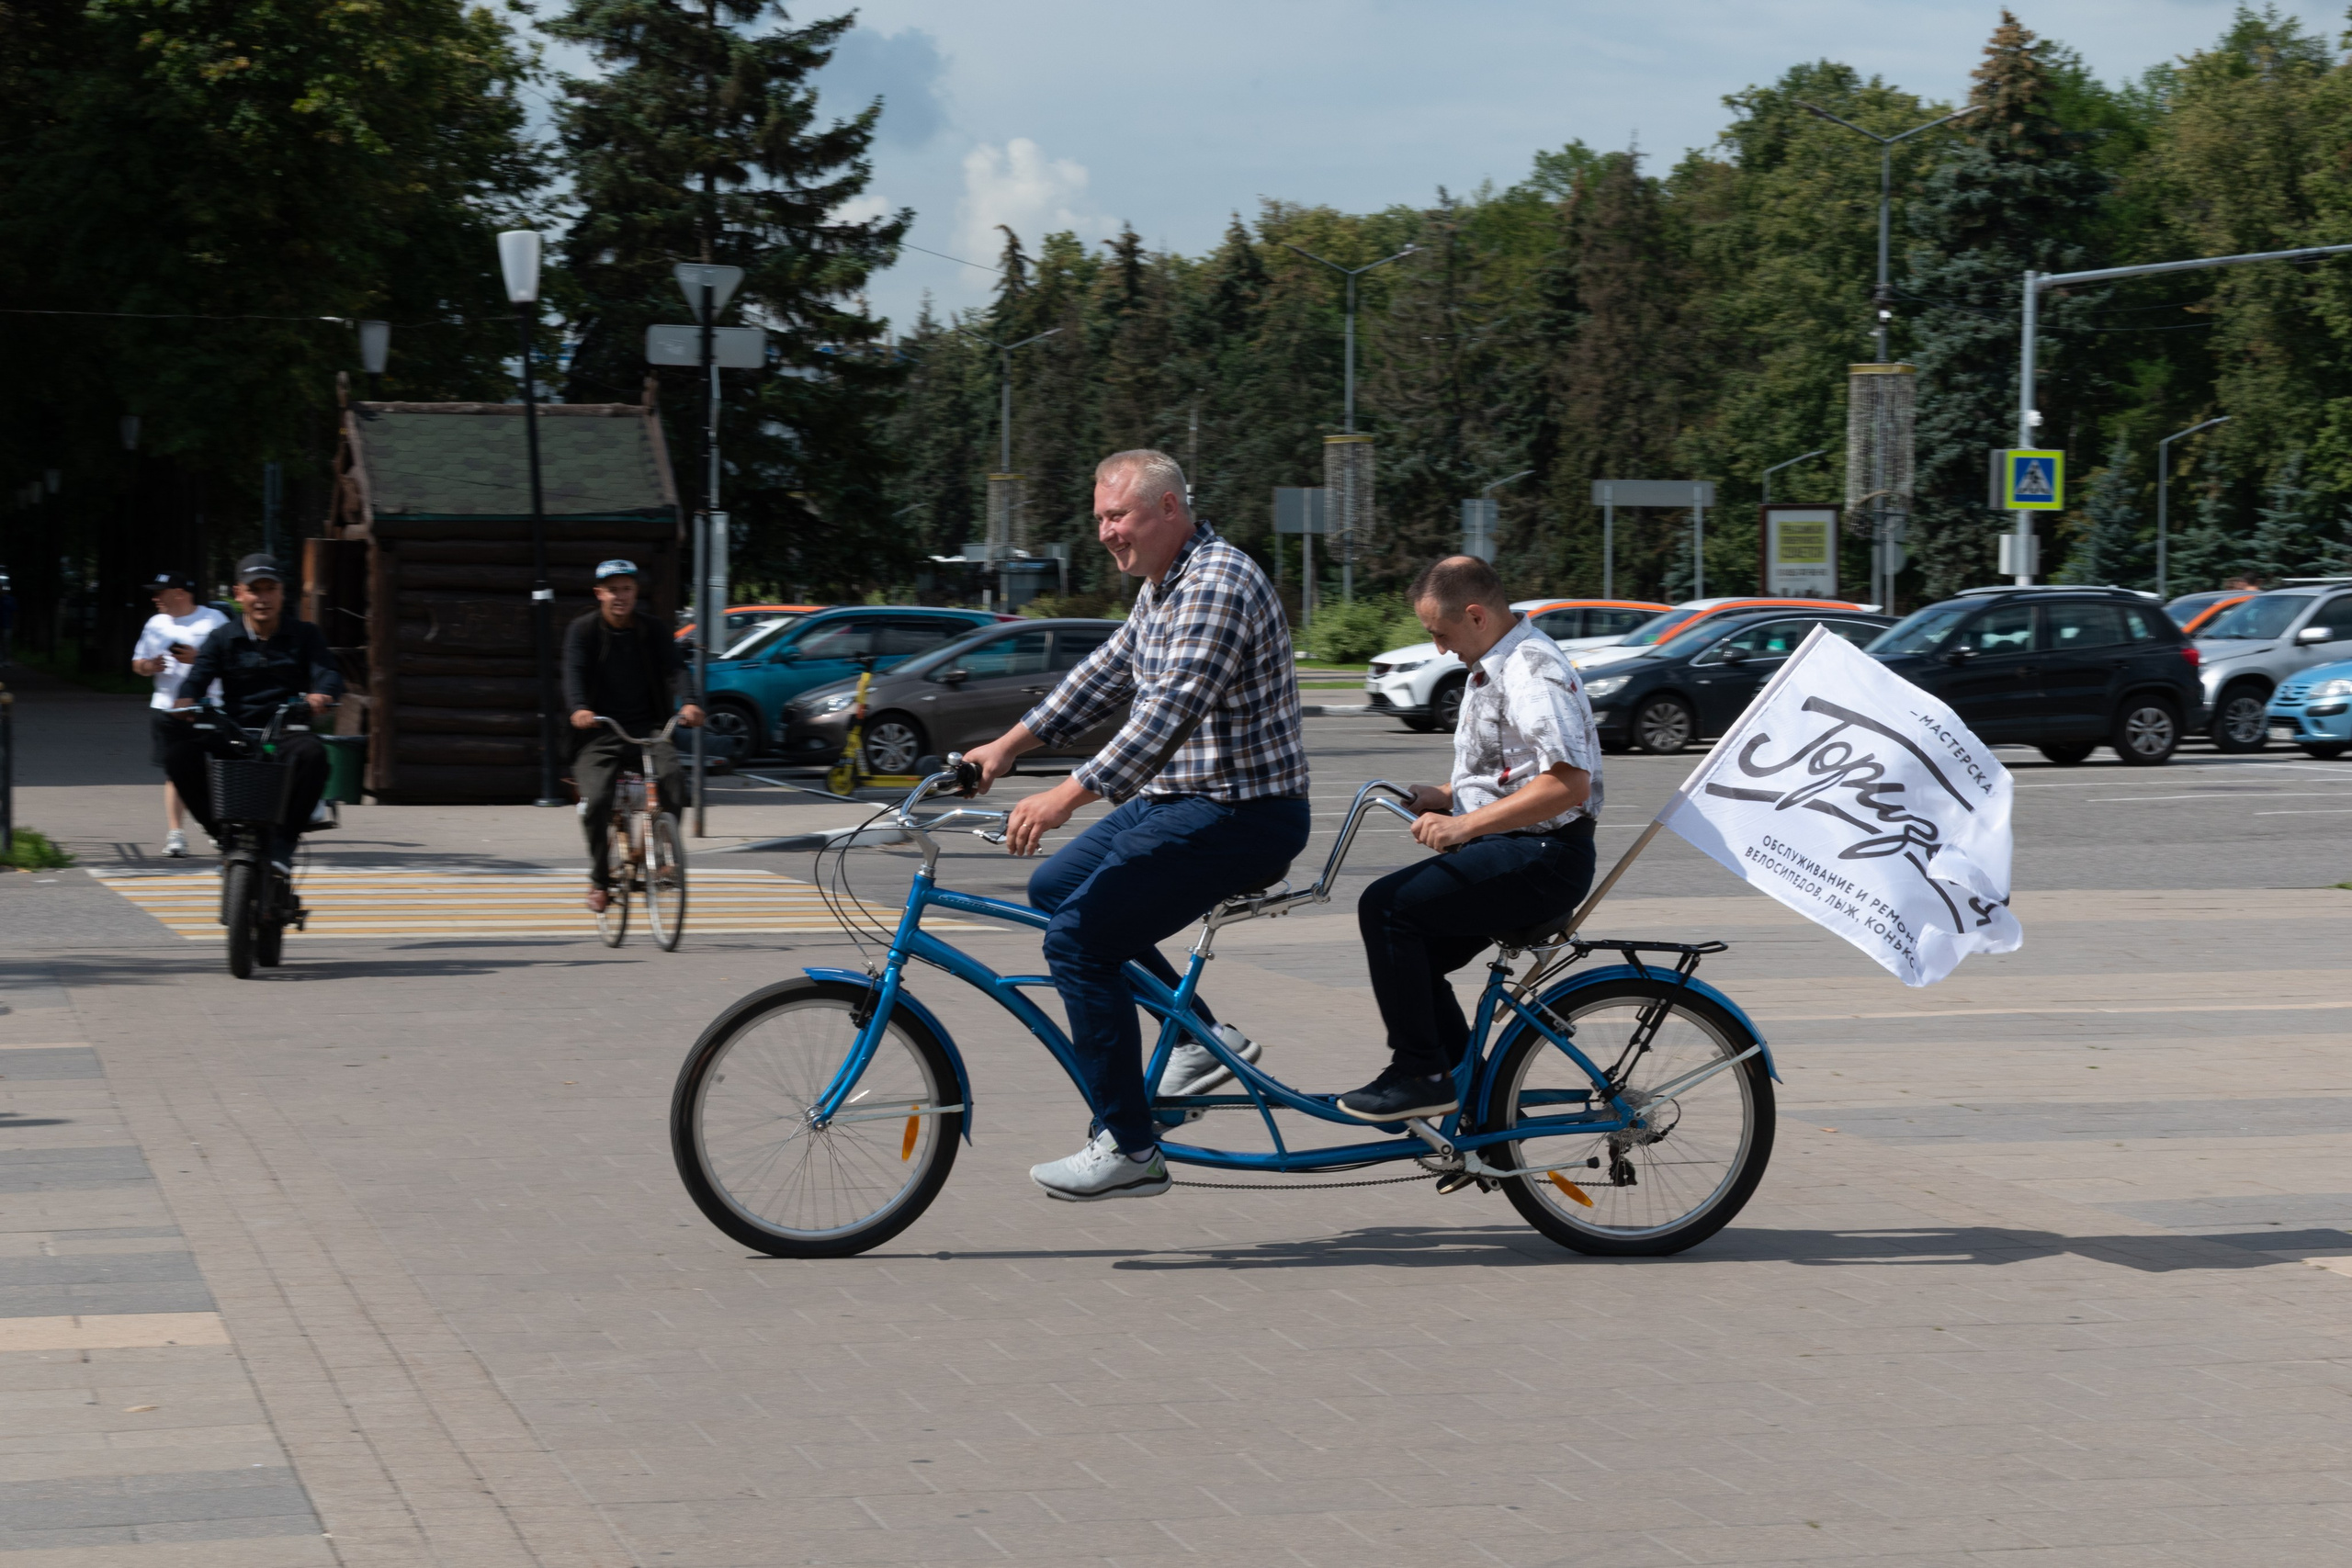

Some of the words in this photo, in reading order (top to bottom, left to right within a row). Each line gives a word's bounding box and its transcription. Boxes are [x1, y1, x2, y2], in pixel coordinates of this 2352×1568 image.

[1919, 716, 1997, 797] МАСТЕРСКА
[1745, 846, 1822, 901] ВЕЛОСИПЕДОВ,
[1825, 894, 1860, 923] ЛЫЖ,
[1762, 835, 1855, 895] ОБСЛУЖИВАНИЕ
[1855, 889, 1869, 902] И
